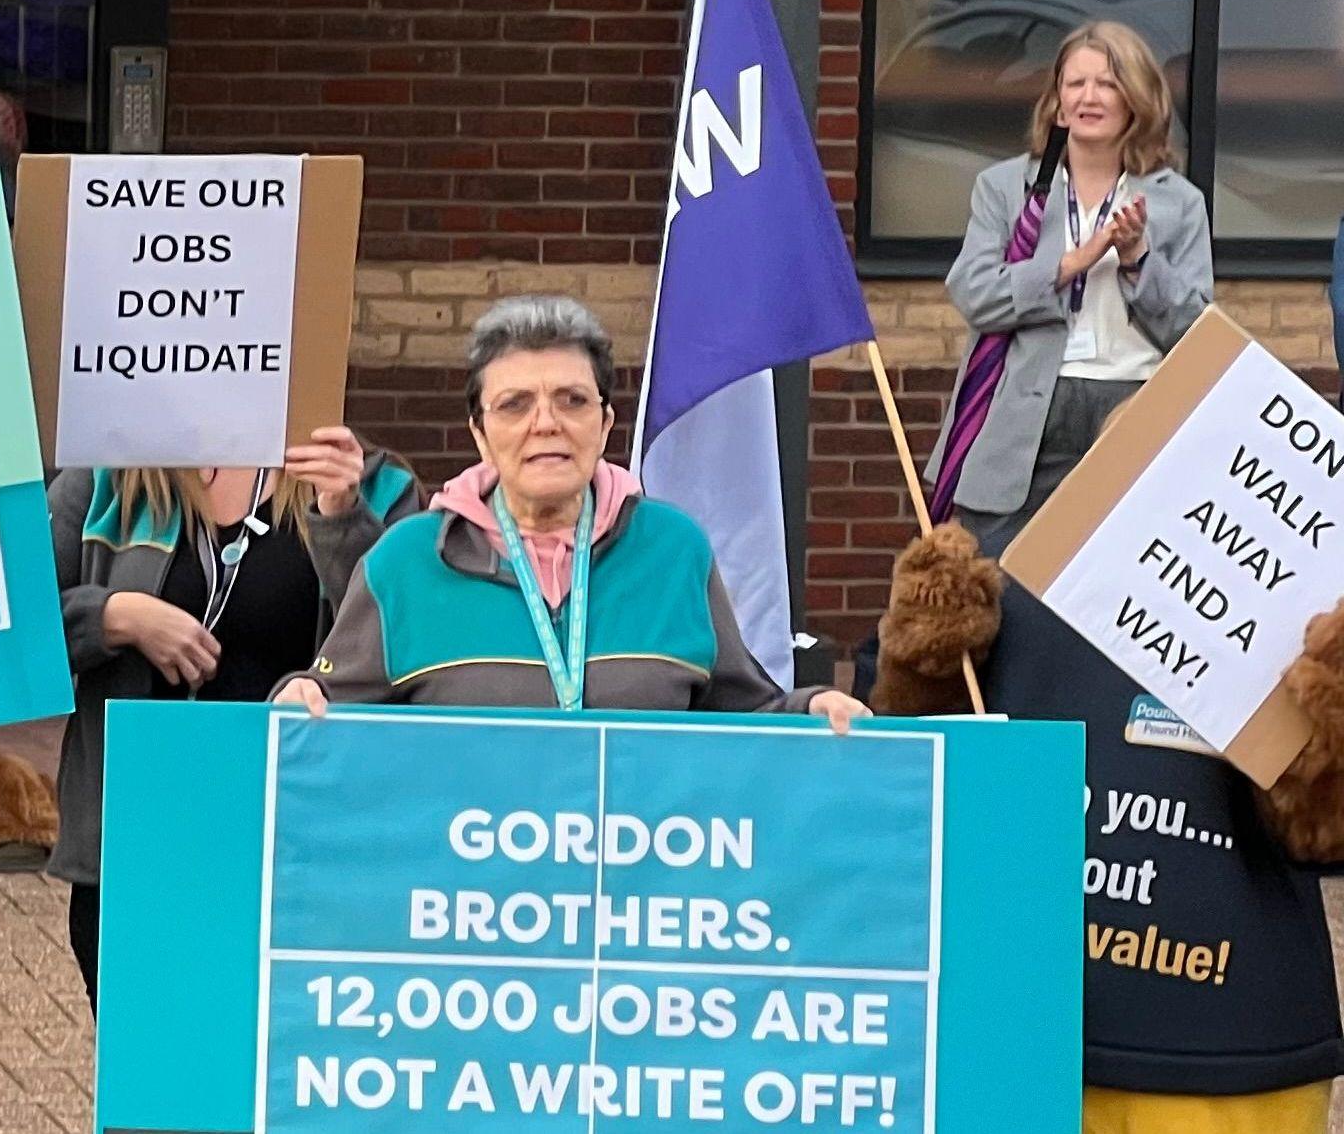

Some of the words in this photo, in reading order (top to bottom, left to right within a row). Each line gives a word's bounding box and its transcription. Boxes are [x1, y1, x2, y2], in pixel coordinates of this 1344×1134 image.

[85, 178, 187, 209] SAVE
[197, 178, 286, 208] OUR
[132, 233, 232, 264] JOBS
[72, 343, 282, 380] LIQUIDATE
[1229, 444, 1336, 550] WALK
[1183, 500, 1296, 591] AWAY
[1138, 538, 1229, 621] FIND
[1226, 618, 1258, 653] A
[1116, 596, 1210, 688] WAY!
[449, 808, 754, 869] GORDON
[409, 888, 791, 953] BROTHERS.
[1087, 922, 1231, 985] value!
[306, 975, 538, 1038] 12,000
[553, 982, 737, 1040] JOBS
[752, 990, 889, 1046] ARE
[295, 1055, 437, 1111] NOT
[448, 1061, 496, 1114] A
[510, 1063, 726, 1121] WRITE
[744, 1070, 898, 1129] OFF!
